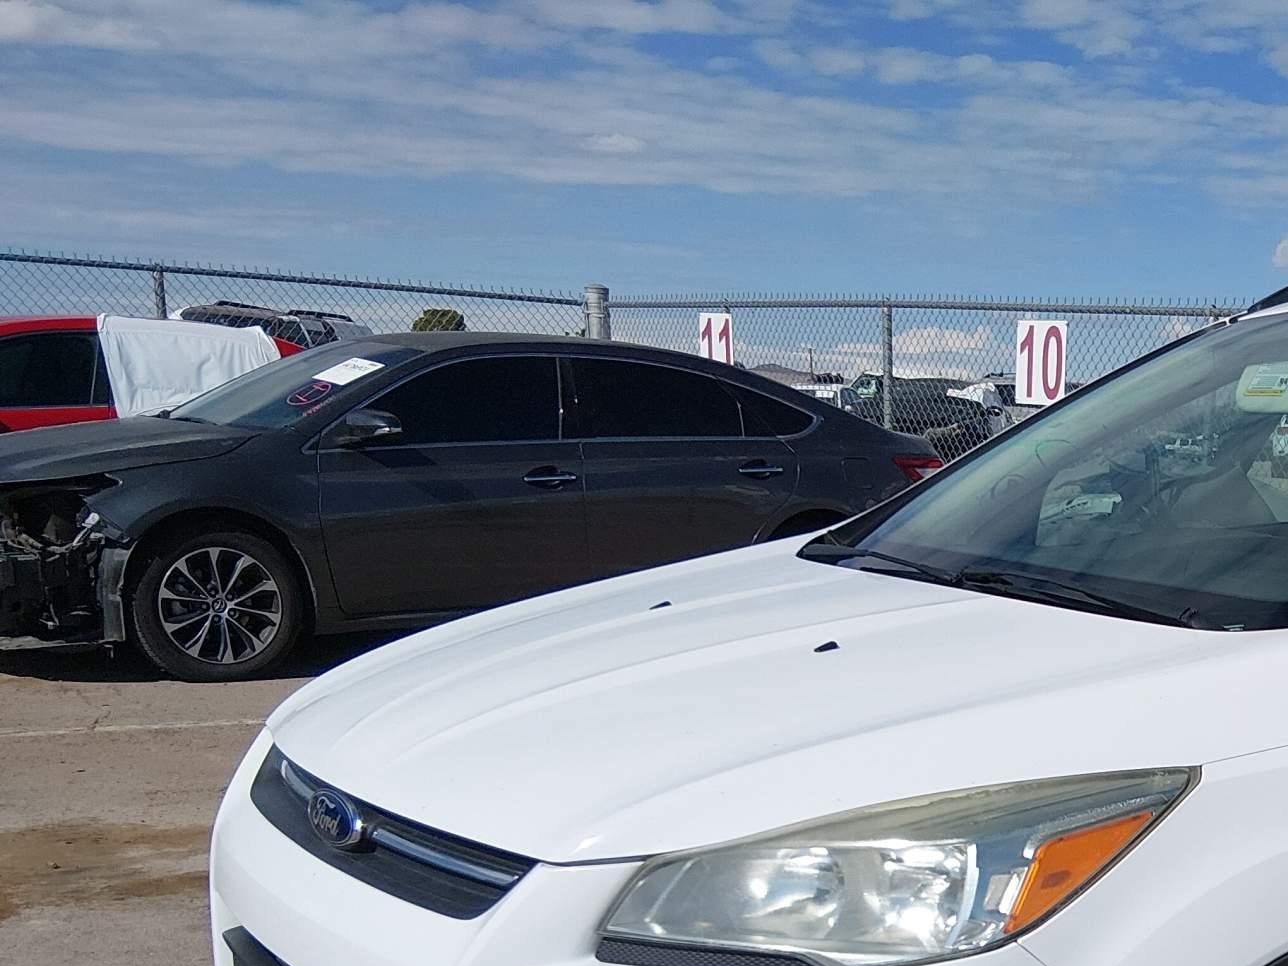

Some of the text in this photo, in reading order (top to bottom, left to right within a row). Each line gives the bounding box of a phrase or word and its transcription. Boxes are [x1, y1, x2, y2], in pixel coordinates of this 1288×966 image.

[701, 317, 731, 366] 11
[1020, 326, 1063, 401] 10
[312, 796, 341, 836] Ford
